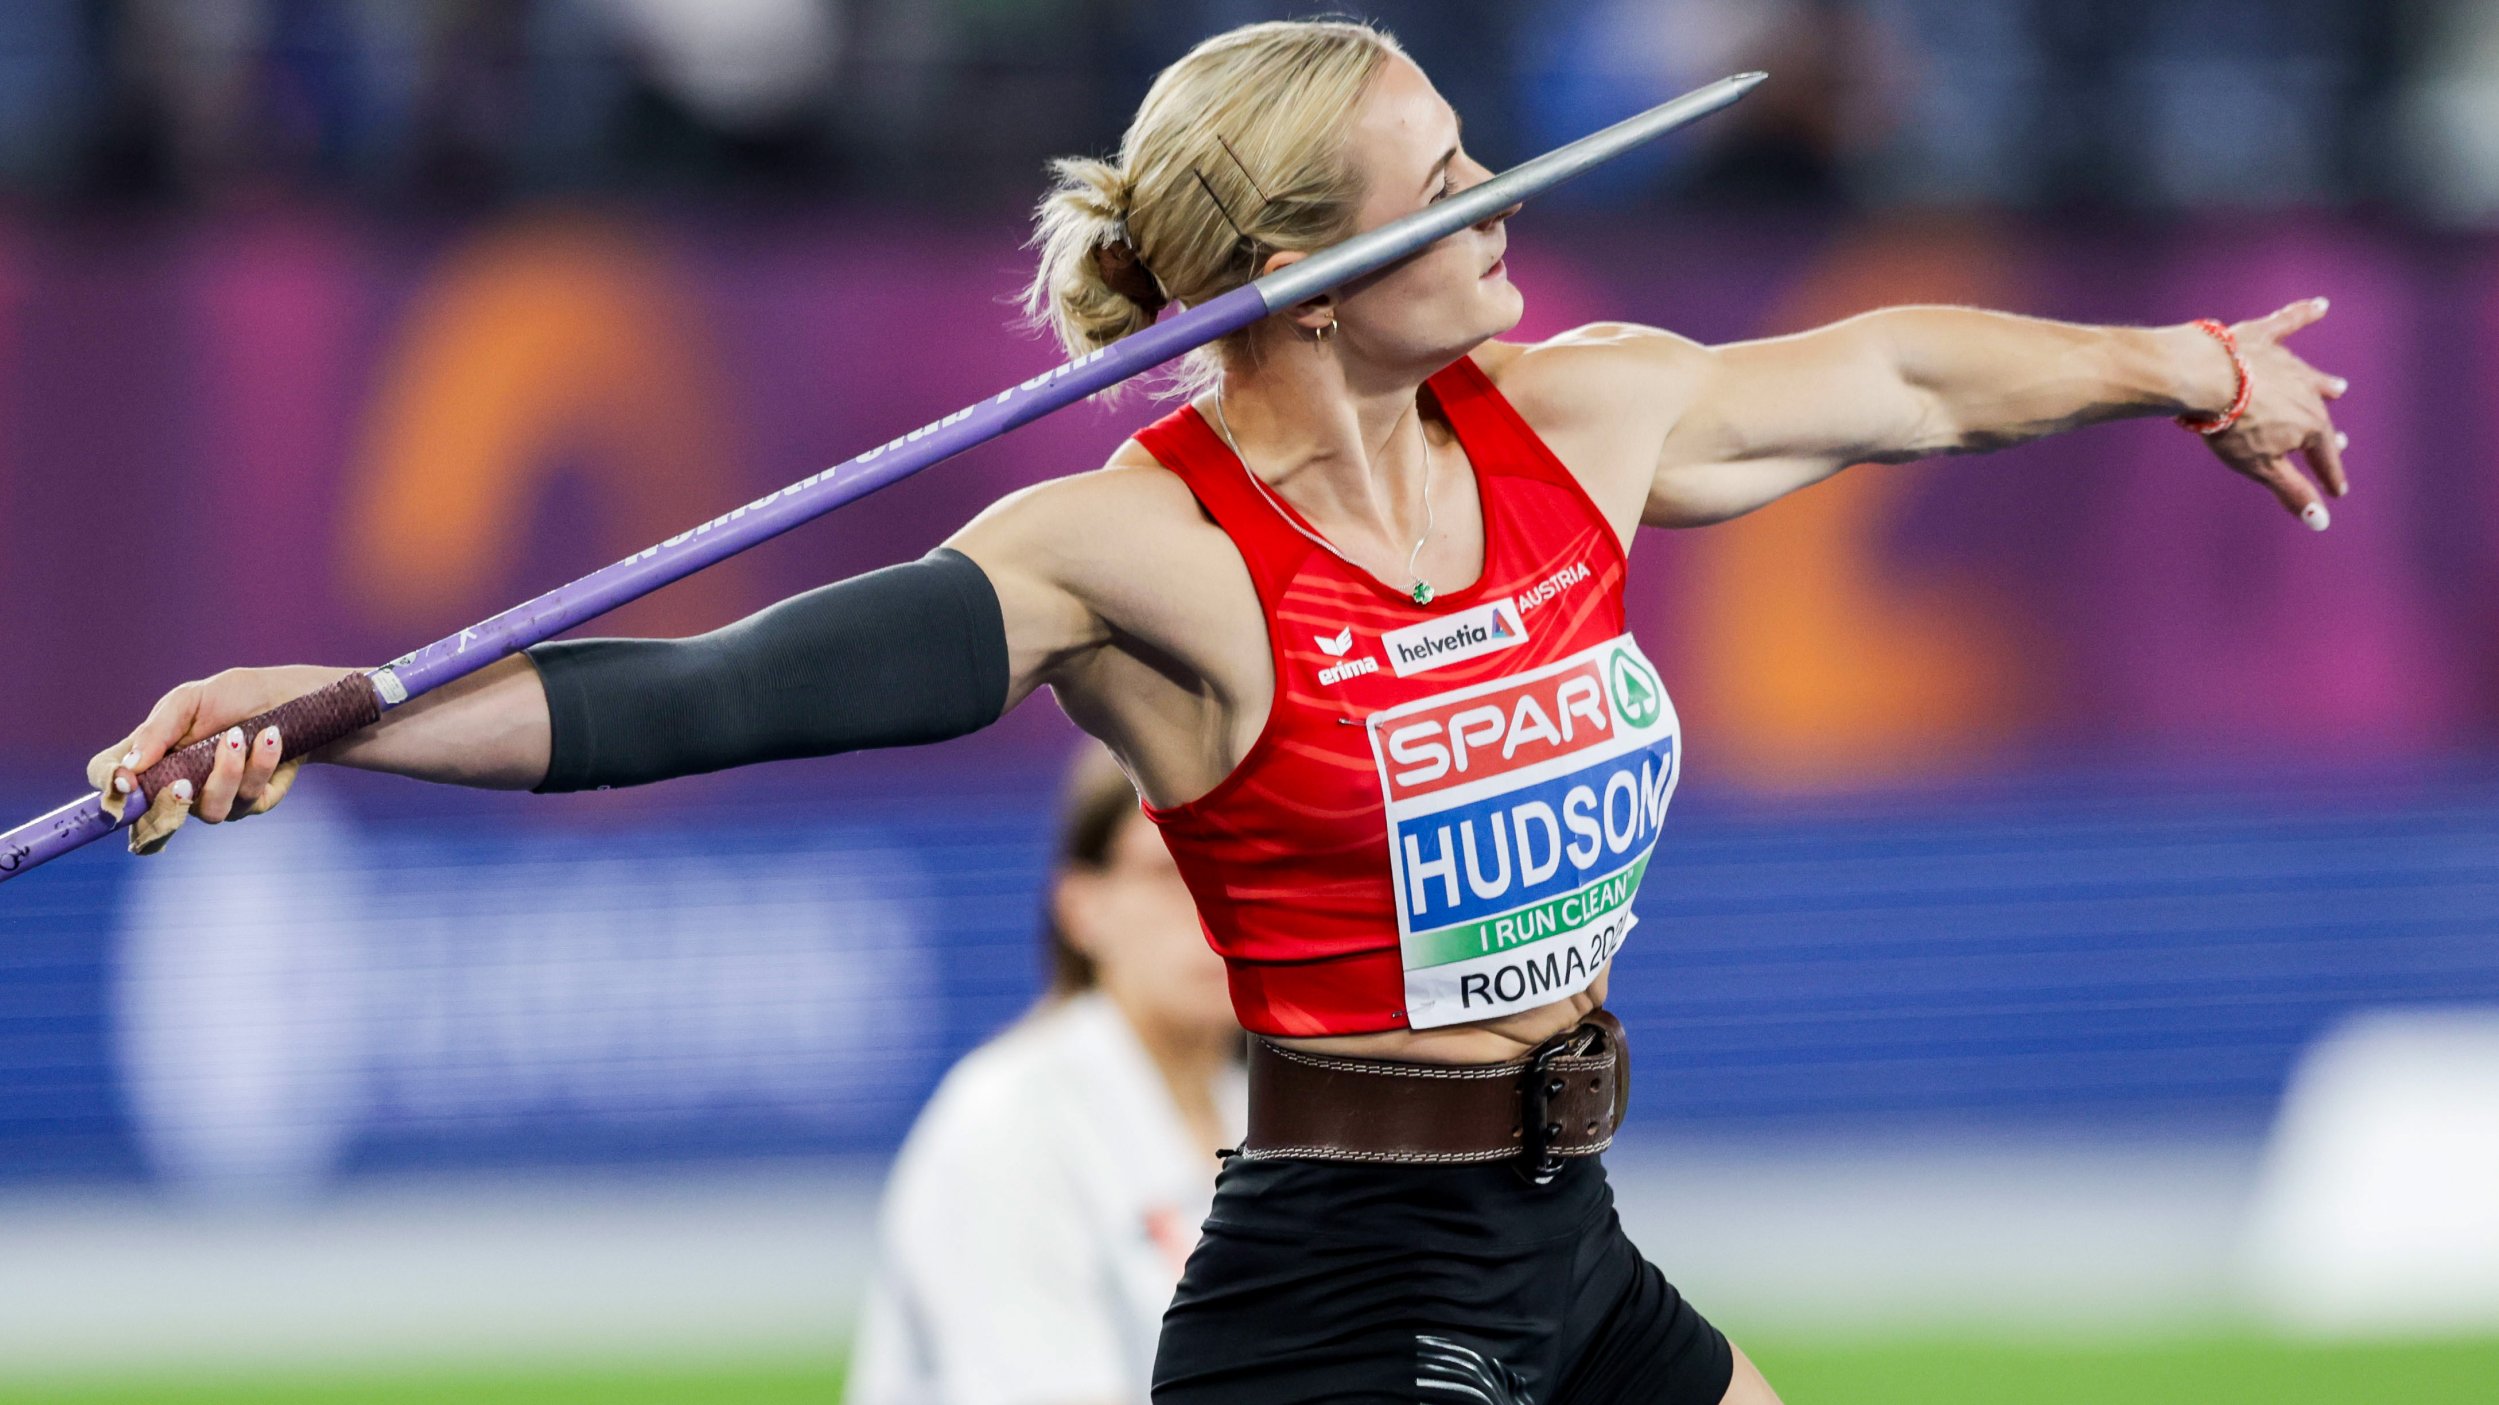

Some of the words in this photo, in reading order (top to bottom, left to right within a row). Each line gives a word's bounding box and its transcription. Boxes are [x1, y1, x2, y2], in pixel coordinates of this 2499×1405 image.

[1518, 561, 1591, 614] AUSTRIA
[1397, 624, 1488, 664] helvetia
[1317, 656, 1379, 686] erima
[1388, 674, 1606, 787] SPAR
[1403, 751, 1671, 916] HUDSON
[1480, 922, 1489, 951] I
[1494, 905, 1556, 948] RUN
[1460, 945, 1586, 1008] ROMA
